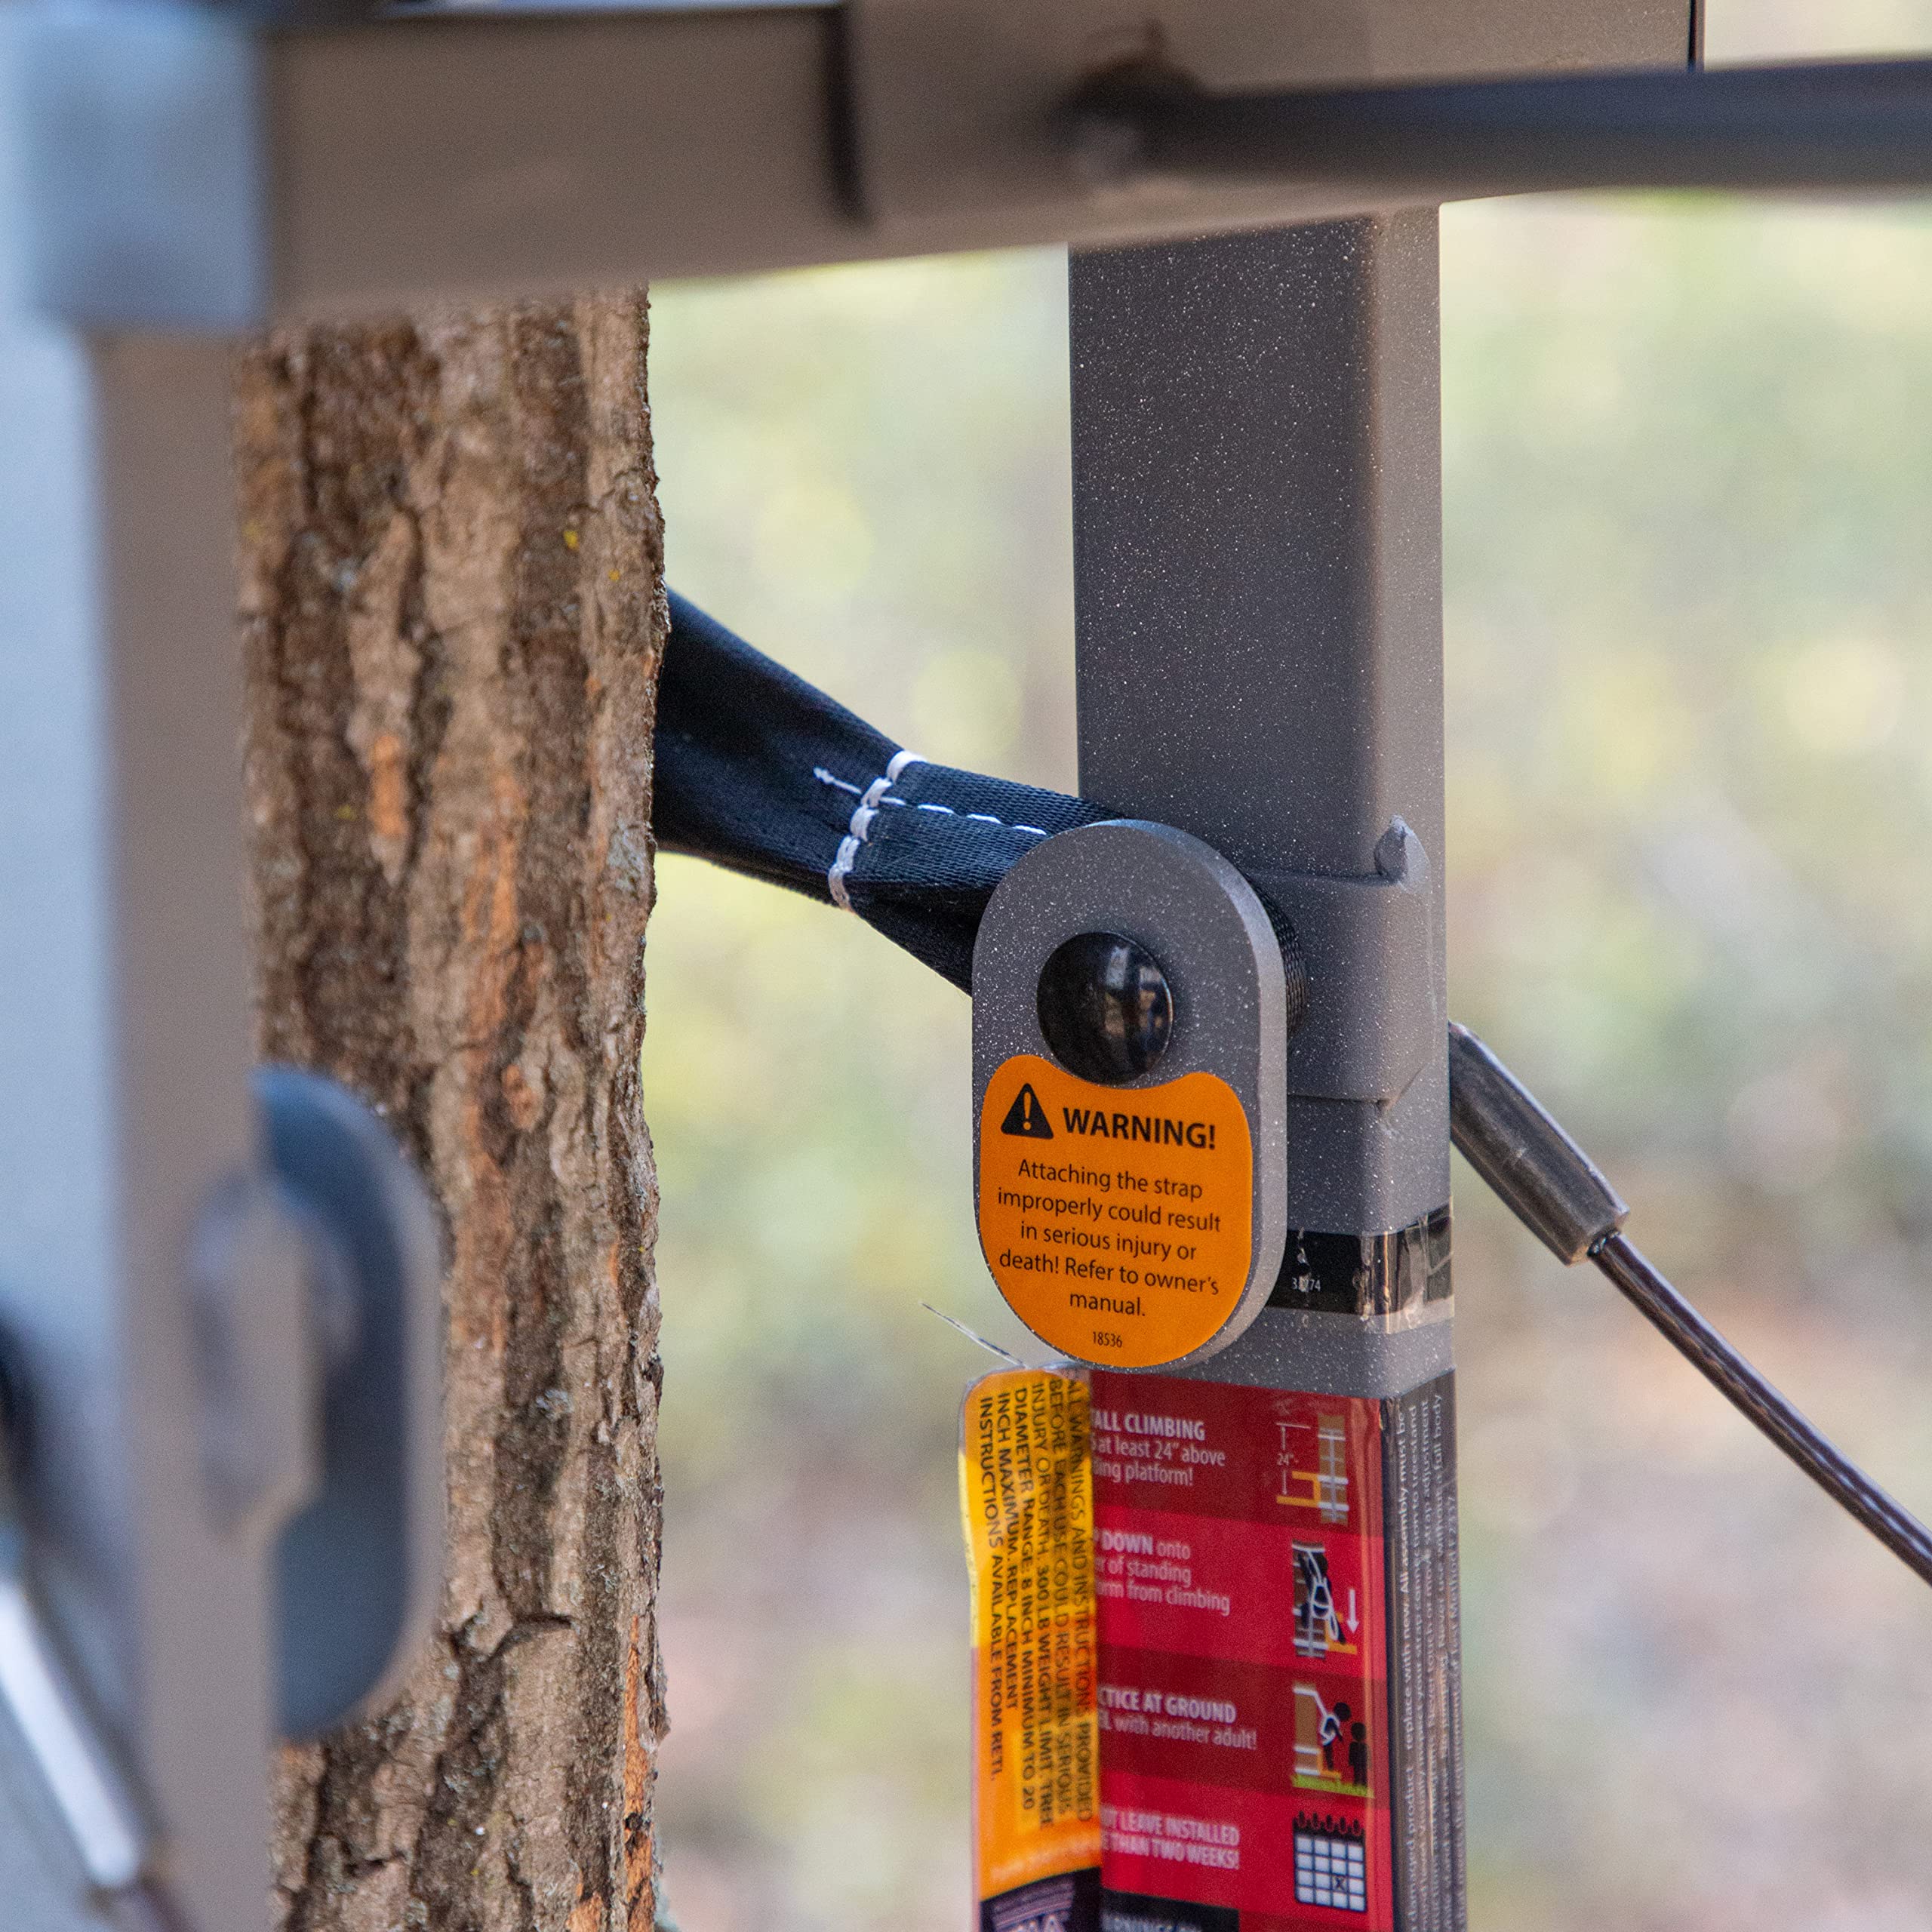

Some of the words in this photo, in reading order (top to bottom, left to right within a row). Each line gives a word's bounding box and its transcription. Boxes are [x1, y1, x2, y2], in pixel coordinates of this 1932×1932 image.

[1063, 1107, 1217, 1150] WARNING!
[1018, 1158, 1111, 1192] Attaching
[1117, 1170, 1149, 1193] the
[1154, 1179, 1203, 1202] strap
[998, 1187, 1103, 1221] improperly
[1109, 1204, 1161, 1226] could
[1168, 1211, 1220, 1232] result
[1021, 1221, 1037, 1240] in
[1044, 1227, 1110, 1251] serious
[1117, 1233, 1171, 1261] injury
[1177, 1245, 1197, 1260] or
[999, 1249, 1059, 1274] death!
[1066, 1257, 1115, 1281] Refer
[1119, 1266, 1139, 1284] to
[1144, 1274, 1220, 1296] owner's
[1069, 1293, 1146, 1317] manual.
[1092, 1331, 1122, 1348] 18536
[997, 1392, 1011, 1443] INCH
[1032, 1383, 1048, 1451] INJURY
[1050, 1379, 1066, 1454] BEFORE
[1124, 1414, 1205, 1441] CLIMBING
[1396, 1412, 1406, 1435] be
[1432, 1395, 1442, 1438] body
[1015, 1388, 1034, 1493] DIAMETER
[1098, 1436, 1112, 1454] at
[1115, 1435, 1151, 1458] least
[1182, 1444, 1225, 1467] above
[1398, 1438, 1407, 1482] must
[1408, 1405, 1418, 1489] treestand
[1421, 1401, 1431, 1498] adjustment
[1433, 1443, 1442, 1471] full
[980, 1397, 1004, 1549] INSTRUCTIONS
[1036, 1457, 1051, 1486] OR
[1069, 1416, 1086, 1520] WARNINGS
[1125, 1461, 1194, 1487] platform!
[998, 1448, 1019, 1562] MAXIMUM.
[1411, 1491, 1419, 1510] to
[1038, 1491, 1050, 1560] DEATH.
[1054, 1516, 1067, 1552] USE
[1398, 1486, 1409, 1567] assembly
[1423, 1501, 1432, 1545] strap
[1435, 1491, 1444, 1555] without
[1072, 1527, 1087, 1570] AND
[1102, 1530, 1153, 1555] DOWN
[1157, 1541, 1191, 1561] onto
[1022, 1579, 1032, 1590] 8
[1038, 1567, 1050, 1600] 300
[1055, 1558, 1069, 1628] COULD
[1108, 1555, 1124, 1574] of
[1127, 1559, 1192, 1589] standing
[1400, 1571, 1409, 1594] All
[991, 1555, 1004, 1663] AVAILABLE
[1038, 1606, 1051, 1630] LB
[1128, 1578, 1162, 1604] from
[1166, 1586, 1230, 1617] climbing
[1006, 1564, 1018, 1709] REPLACEMENT
[1022, 1595, 1033, 1645] INCH
[1414, 1614, 1423, 1658] strap
[1056, 1632, 1072, 1700] RESULT
[1074, 1575, 1091, 1717] INSTRUCTIONS
[1401, 1644, 1411, 1684] with
[1038, 1633, 1051, 1714] WEIGHT
[991, 1666, 1003, 1727] FROM
[1022, 1650, 1035, 1750] MINIMUM
[1057, 1707, 1072, 1727] IN
[1143, 1691, 1161, 1714] AT
[1164, 1695, 1236, 1724] GROUND
[1403, 1687, 1414, 1750] replace
[1114, 1714, 1149, 1736] with
[1152, 1720, 1210, 1744] another
[1212, 1727, 1257, 1750] adult!
[1023, 1752, 1035, 1780] TO
[1078, 1722, 1093, 1822] PROVIDED
[1023, 1786, 1035, 1810] 20
[1404, 1766, 1416, 1835] product
[1152, 1837, 1185, 1862] TWO
[1166, 1816, 1240, 1847] INSTALLED
